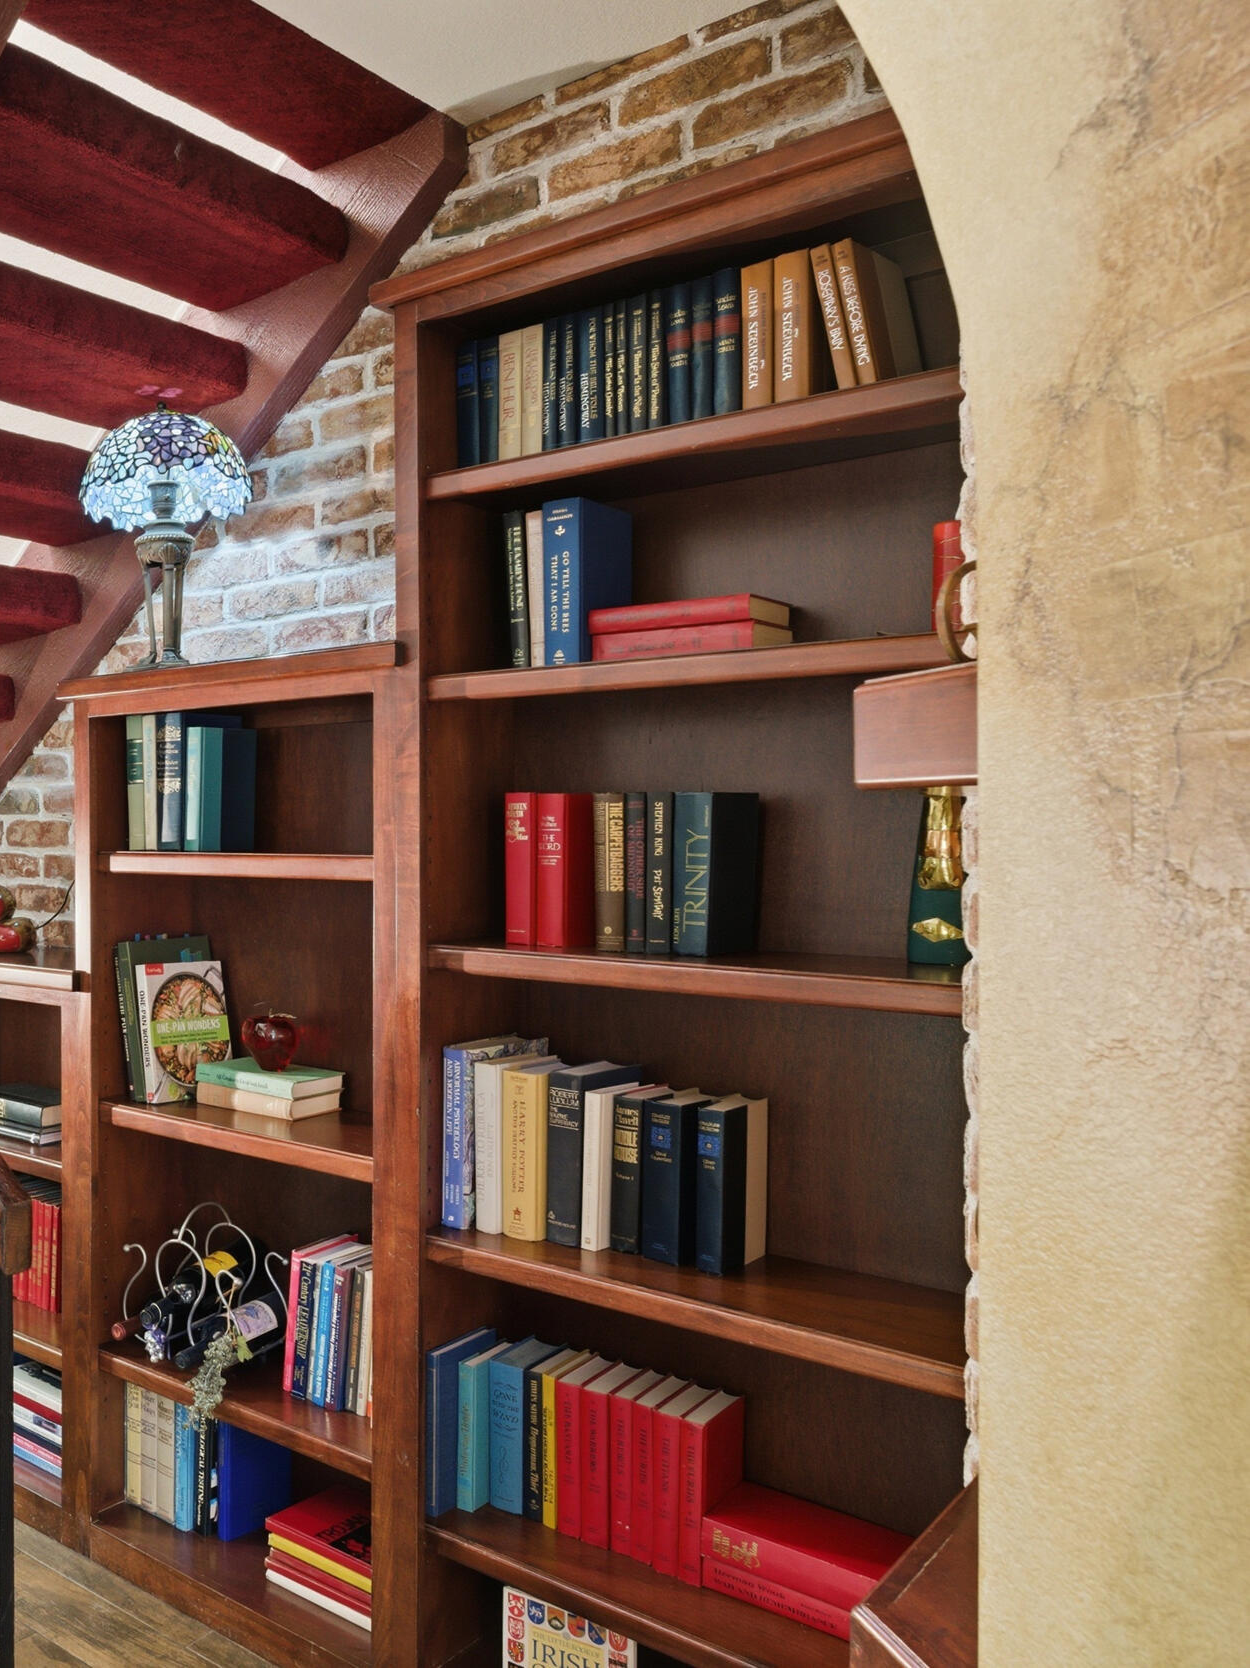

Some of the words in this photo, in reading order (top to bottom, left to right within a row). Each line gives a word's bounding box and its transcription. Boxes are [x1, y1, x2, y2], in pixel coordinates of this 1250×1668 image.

[839, 266, 852, 274] A
[840, 274, 856, 297] KISS
[748, 286, 758, 318] JOHN
[782, 277, 793, 308] JOHN
[817, 269, 840, 328] ROSEMARY'S
[830, 328, 844, 350] BABY
[846, 296, 863, 334] BEFORE
[748, 321, 758, 390] STEINBECK
[782, 311, 793, 382] STEINBECK
[854, 334, 870, 366] DYING
[580, 373, 590, 428] HEMINGWAY
[550, 555, 558, 581] THAT
[562, 551, 570, 566] GO
[562, 567, 570, 590] TELL
[550, 588, 558, 604] AM
[562, 590, 570, 610] THE
[550, 605, 558, 632] GONE
[561, 612, 570, 634] BEES
[610, 802, 623, 819] THE
[654, 802, 663, 834] STEPHEN
[635, 818, 644, 838] THE
[610, 819, 623, 892] CARPETBAGGERS
[635, 840, 644, 876] OTHER
[654, 838, 663, 856] KING
[627, 839, 636, 892] MIDNIGHT
[682, 828, 708, 932] TRINITY
[635, 876, 644, 900] SIDE
[156, 1020, 187, 1034] ONE-PAN
[188, 1018, 221, 1032] WONDERS
[446, 1058, 454, 1078] AND
[446, 1078, 454, 1114] MODERN
[446, 1114, 454, 1136] LIFE
[452, 1107, 461, 1161] PSYCHOLOGY
[518, 1100, 526, 1144] HARRY
[518, 1150, 526, 1192] POTTER
[298, 1275, 311, 1306] Century
[296, 1305, 310, 1360] LEADERSHIP
[529, 1472, 539, 1494] Thief
[532, 1638, 600, 1668] IRISH
